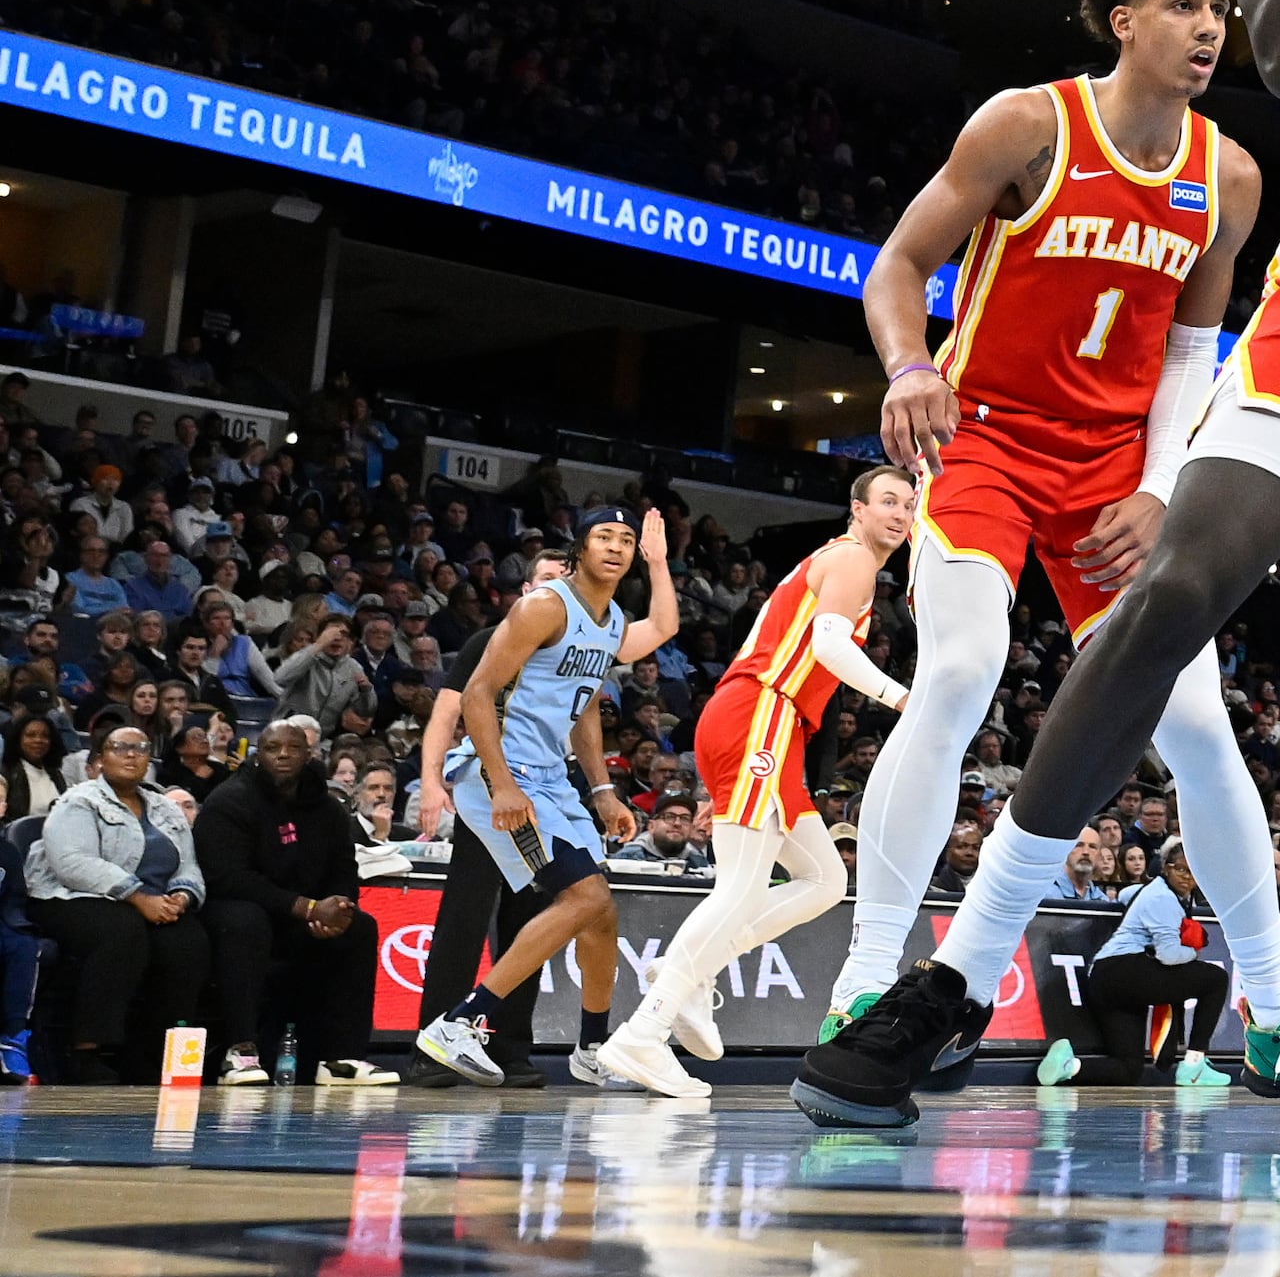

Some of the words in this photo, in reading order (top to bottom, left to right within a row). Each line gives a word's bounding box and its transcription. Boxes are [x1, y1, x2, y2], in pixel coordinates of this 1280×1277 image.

[186, 92, 367, 169] TEQUILA
[1173, 187, 1204, 203] paze
[546, 180, 708, 247] MILAGRO
[721, 222, 860, 285] TEQUILA
[1076, 287, 1125, 361] 1
[456, 455, 489, 480] 104
